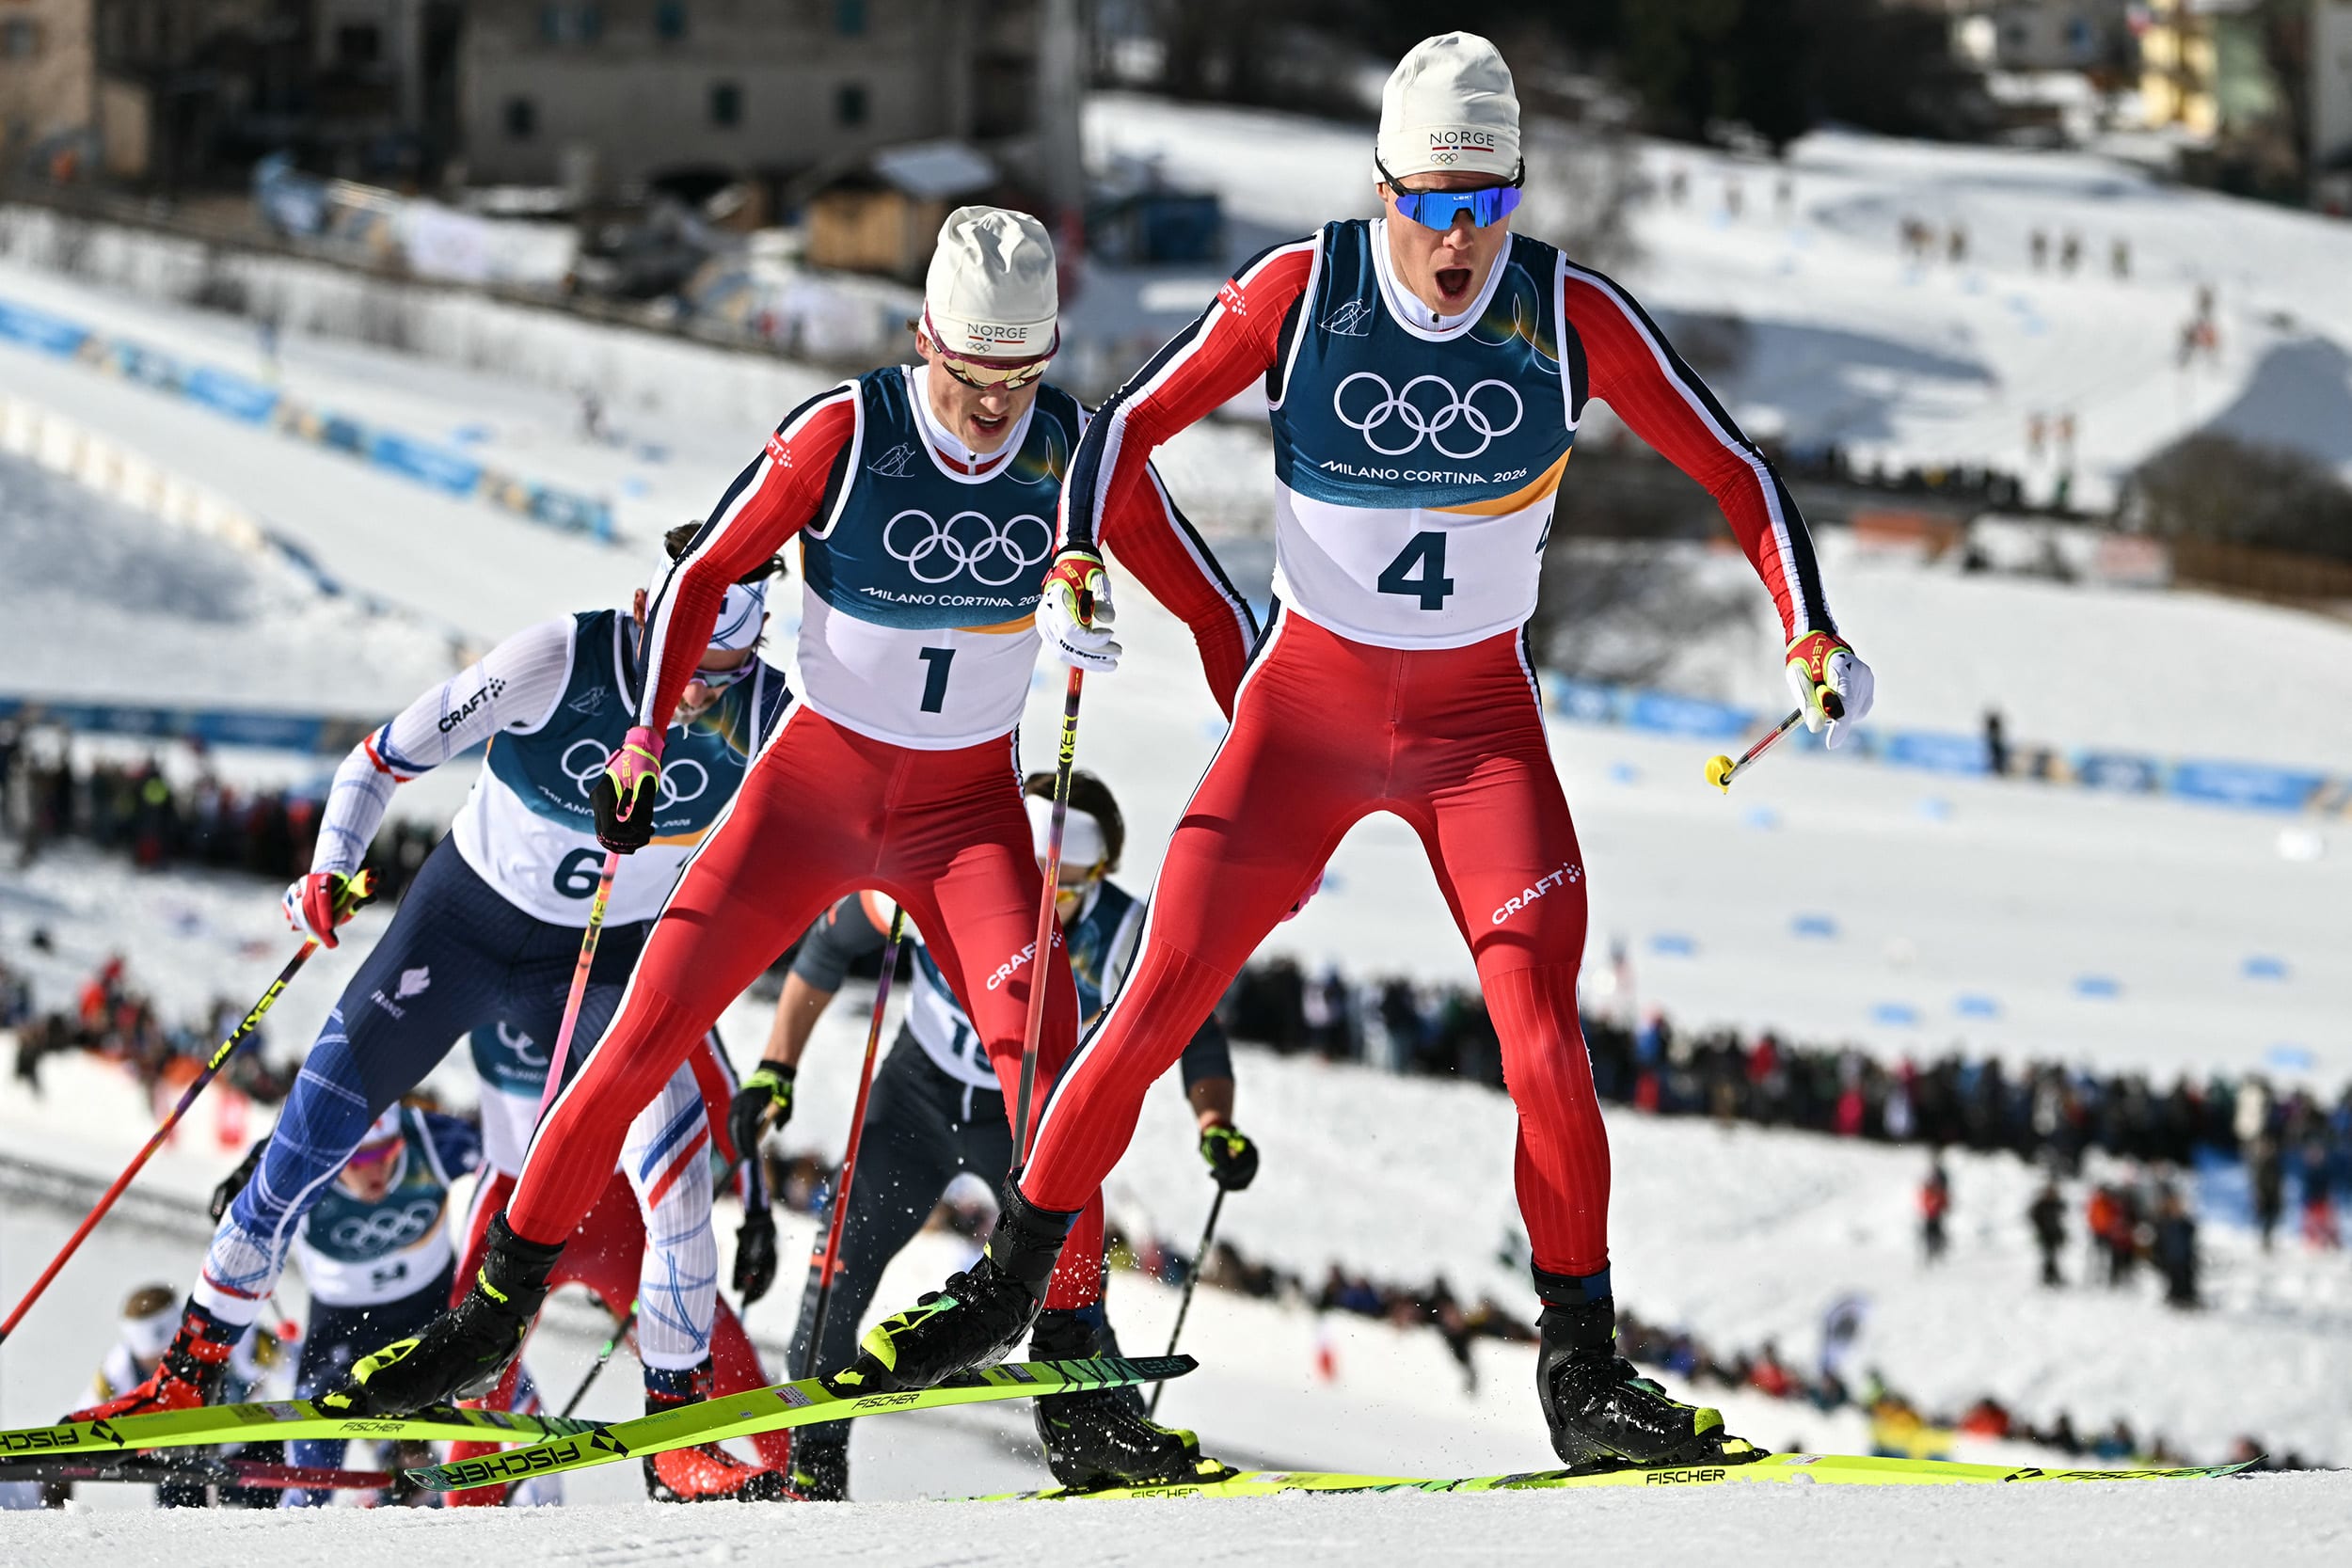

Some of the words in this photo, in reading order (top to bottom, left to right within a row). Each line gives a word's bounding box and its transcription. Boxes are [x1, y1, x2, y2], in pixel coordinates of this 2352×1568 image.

[1430, 131, 1495, 147] NORGE
[967, 323, 1028, 339] NORGE
[1319, 460, 1400, 480] MILANO
[1403, 469, 1488, 484] CORTINA
[1492, 467, 1528, 483] 2026
[1060, 562, 1085, 591] LEKI
[1377, 531, 1454, 610] 4
[859, 587, 936, 605] MILANO
[939, 594, 1014, 608] CORTINA
[1017, 594, 1042, 607] 202
[1811, 638, 1827, 674] LEKI
[918, 646, 957, 714] 1
[438, 686, 488, 733] CRAFT
[553, 847, 608, 899] 6
[1491, 869, 1564, 925] CRAFT
[986, 941, 1037, 990] CRAF
[851, 1393, 920, 1410] FISCHER
[340, 1421, 405, 1433] FISCHER
[440, 1441, 581, 1486] FISCHER
[1646, 1469, 1726, 1484] FISCHER
